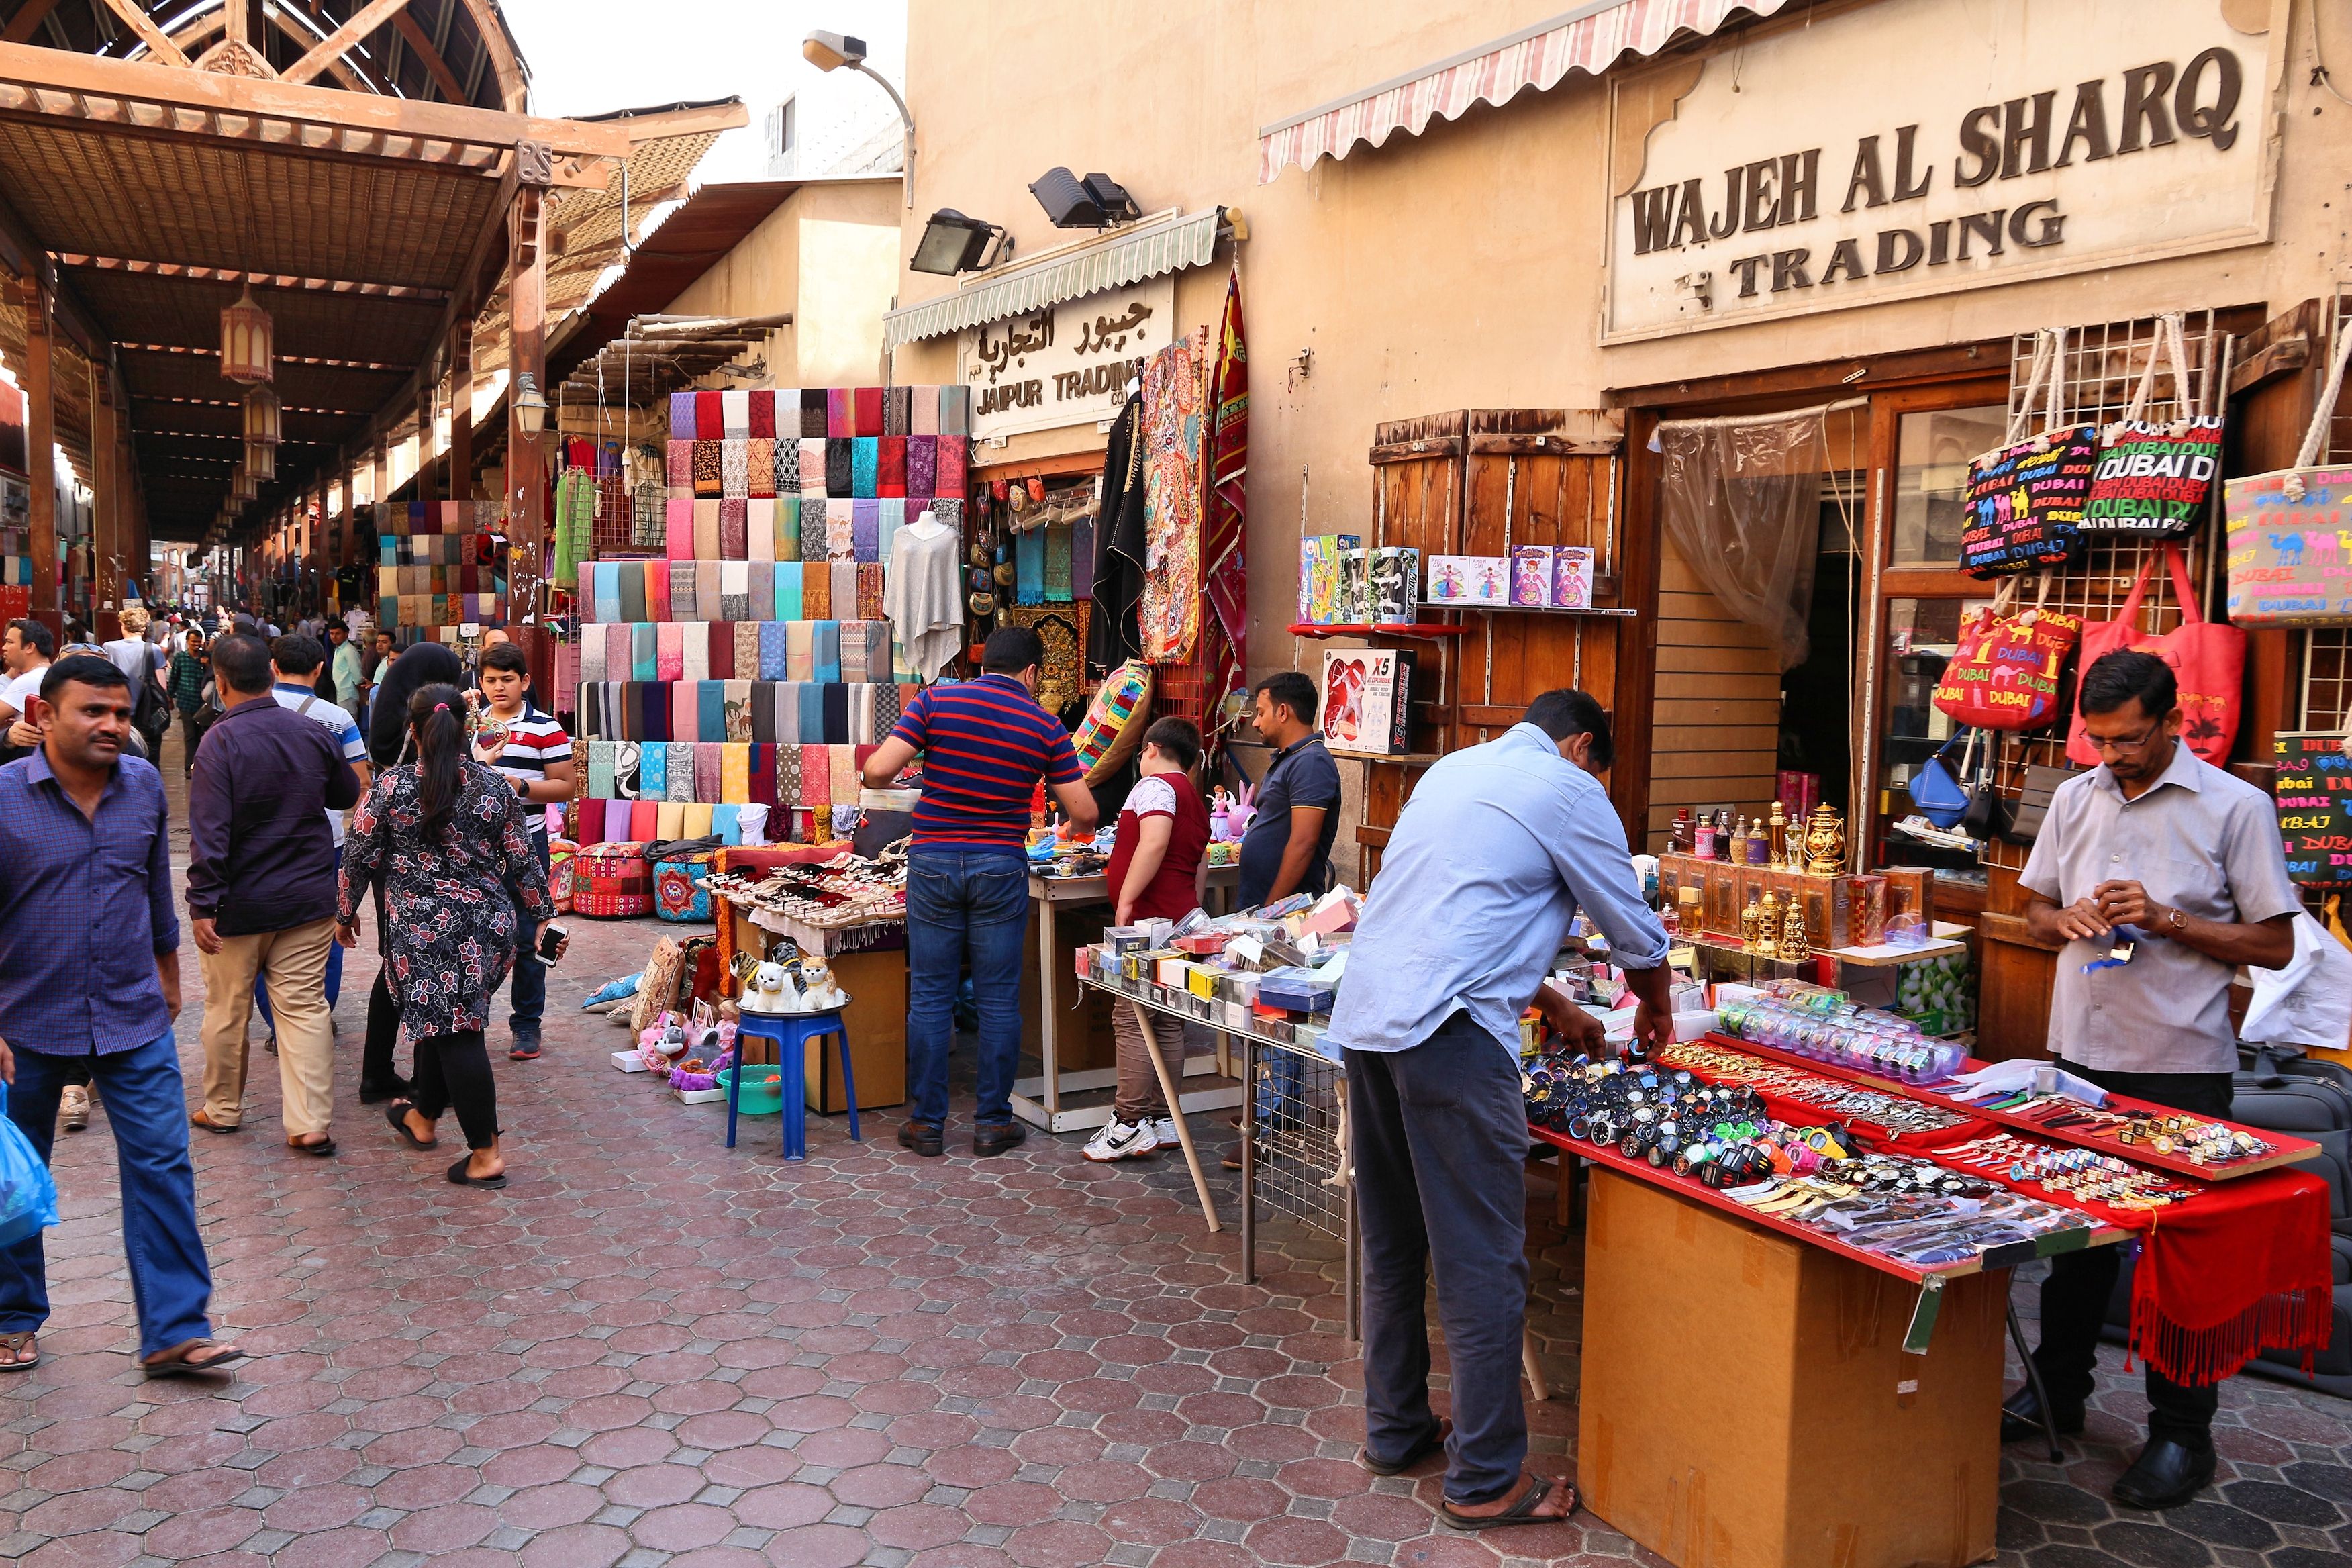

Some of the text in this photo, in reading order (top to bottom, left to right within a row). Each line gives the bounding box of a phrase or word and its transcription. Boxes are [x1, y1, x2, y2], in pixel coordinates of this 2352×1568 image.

[1632, 47, 2243, 256] WAJEH AL SHARQ
[1731, 200, 2066, 298] TRADING
[978, 302, 1153, 385] جيبور التجارية
[977, 379, 1042, 415] JAIPUR
[2120, 442, 2181, 458] DUBAI
[2017, 464, 2058, 482] DUBAI
[2098, 454, 2186, 481] DUBAI
[1975, 475, 2015, 495] DUBAI
[2032, 479, 2084, 493] DUBAI
[2123, 477, 2167, 489] DUBAI
[2116, 487, 2161, 500] DUBAI
[2032, 497, 2083, 509] DUBAI
[2090, 498, 2161, 518] DUBAI
[2002, 516, 2039, 533] DUBAI
[2012, 527, 2043, 544] DUBAI
[1966, 537, 2004, 554] DUBAI
[1970, 549, 2008, 566] DUBAI
[2251, 583, 2326, 597] DUBAI
[2259, 599, 2327, 611] DUBAI
[2038, 609, 2079, 632] DUBAI
[1998, 648, 2044, 665] DUBAI
[1372, 657, 1390, 675] X5
[1958, 668, 1990, 681] DUBAI
[1990, 691, 2031, 707] DUBAI
[1393, 726, 1406, 749] X5
[2277, 796, 2331, 809] DUBAI
